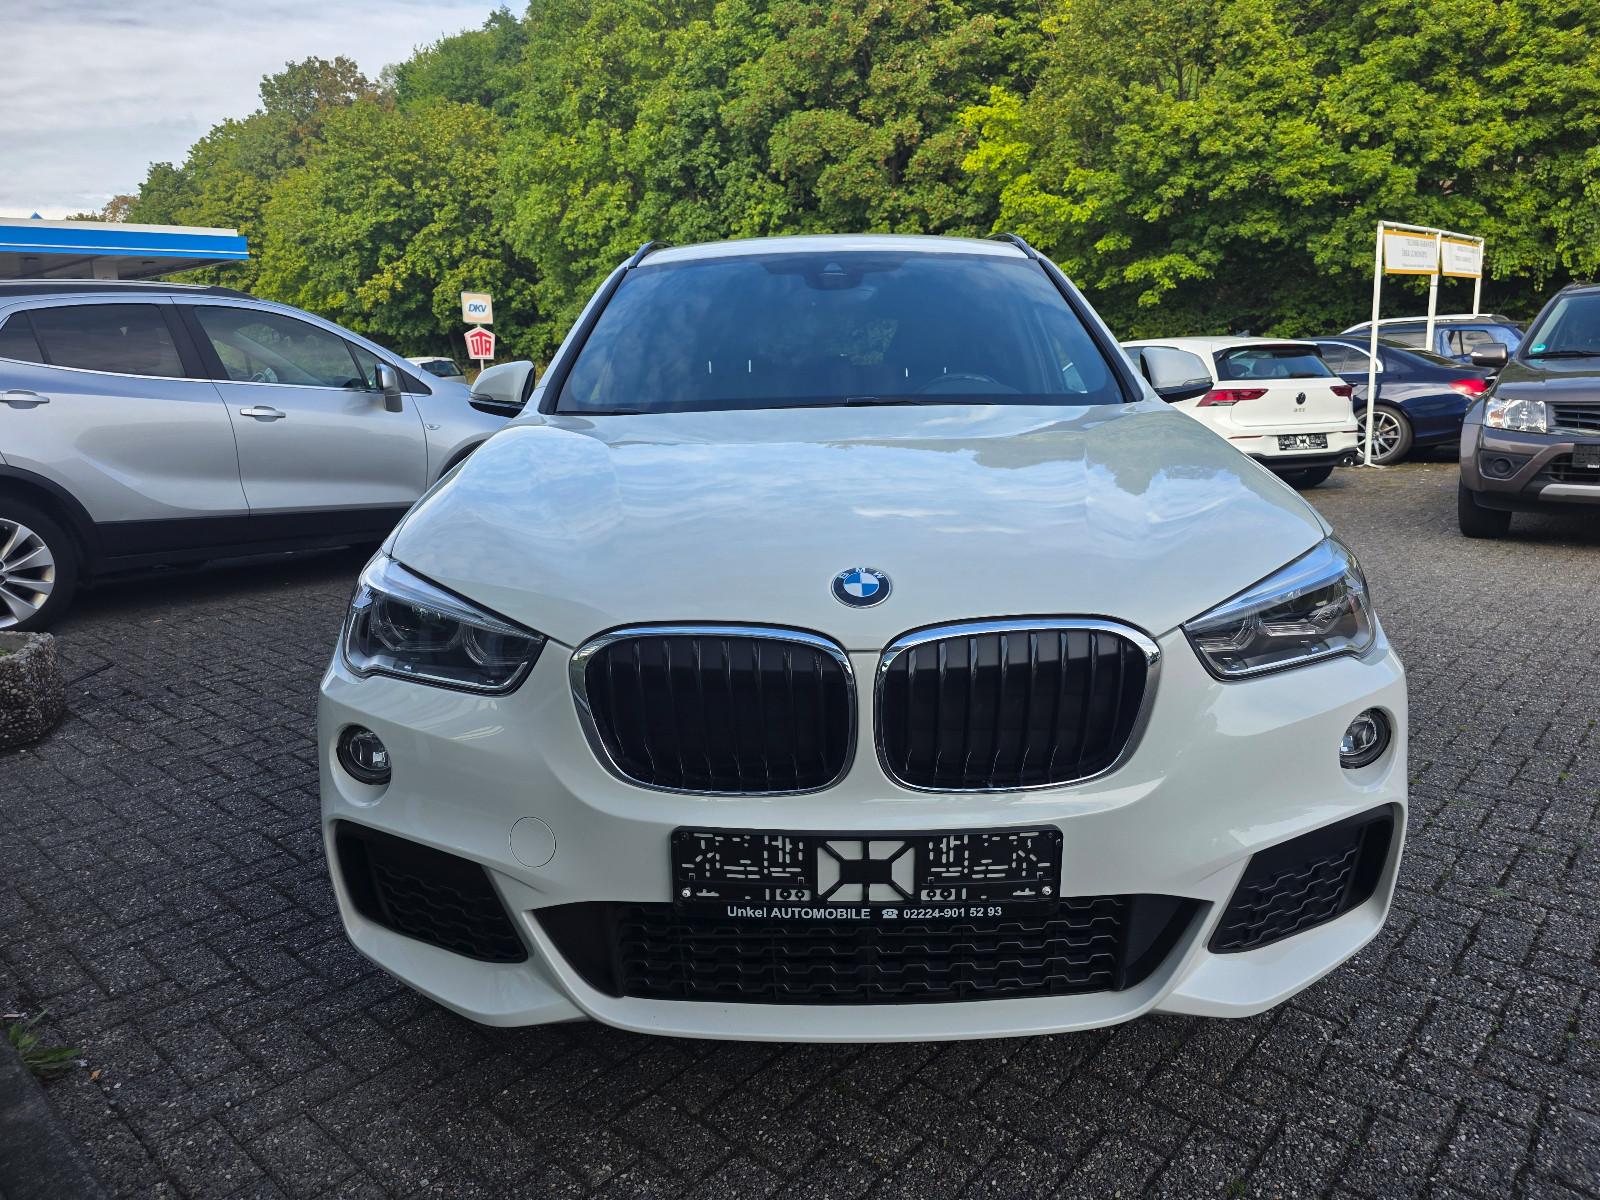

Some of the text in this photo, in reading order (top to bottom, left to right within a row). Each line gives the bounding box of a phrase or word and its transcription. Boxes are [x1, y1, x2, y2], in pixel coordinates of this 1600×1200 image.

[468, 303, 487, 313] DKV
[470, 331, 492, 356] UTA
[840, 567, 885, 579] BMW
[727, 905, 1002, 920] Unkel AUTOMOBILE 02224-901 52 93
